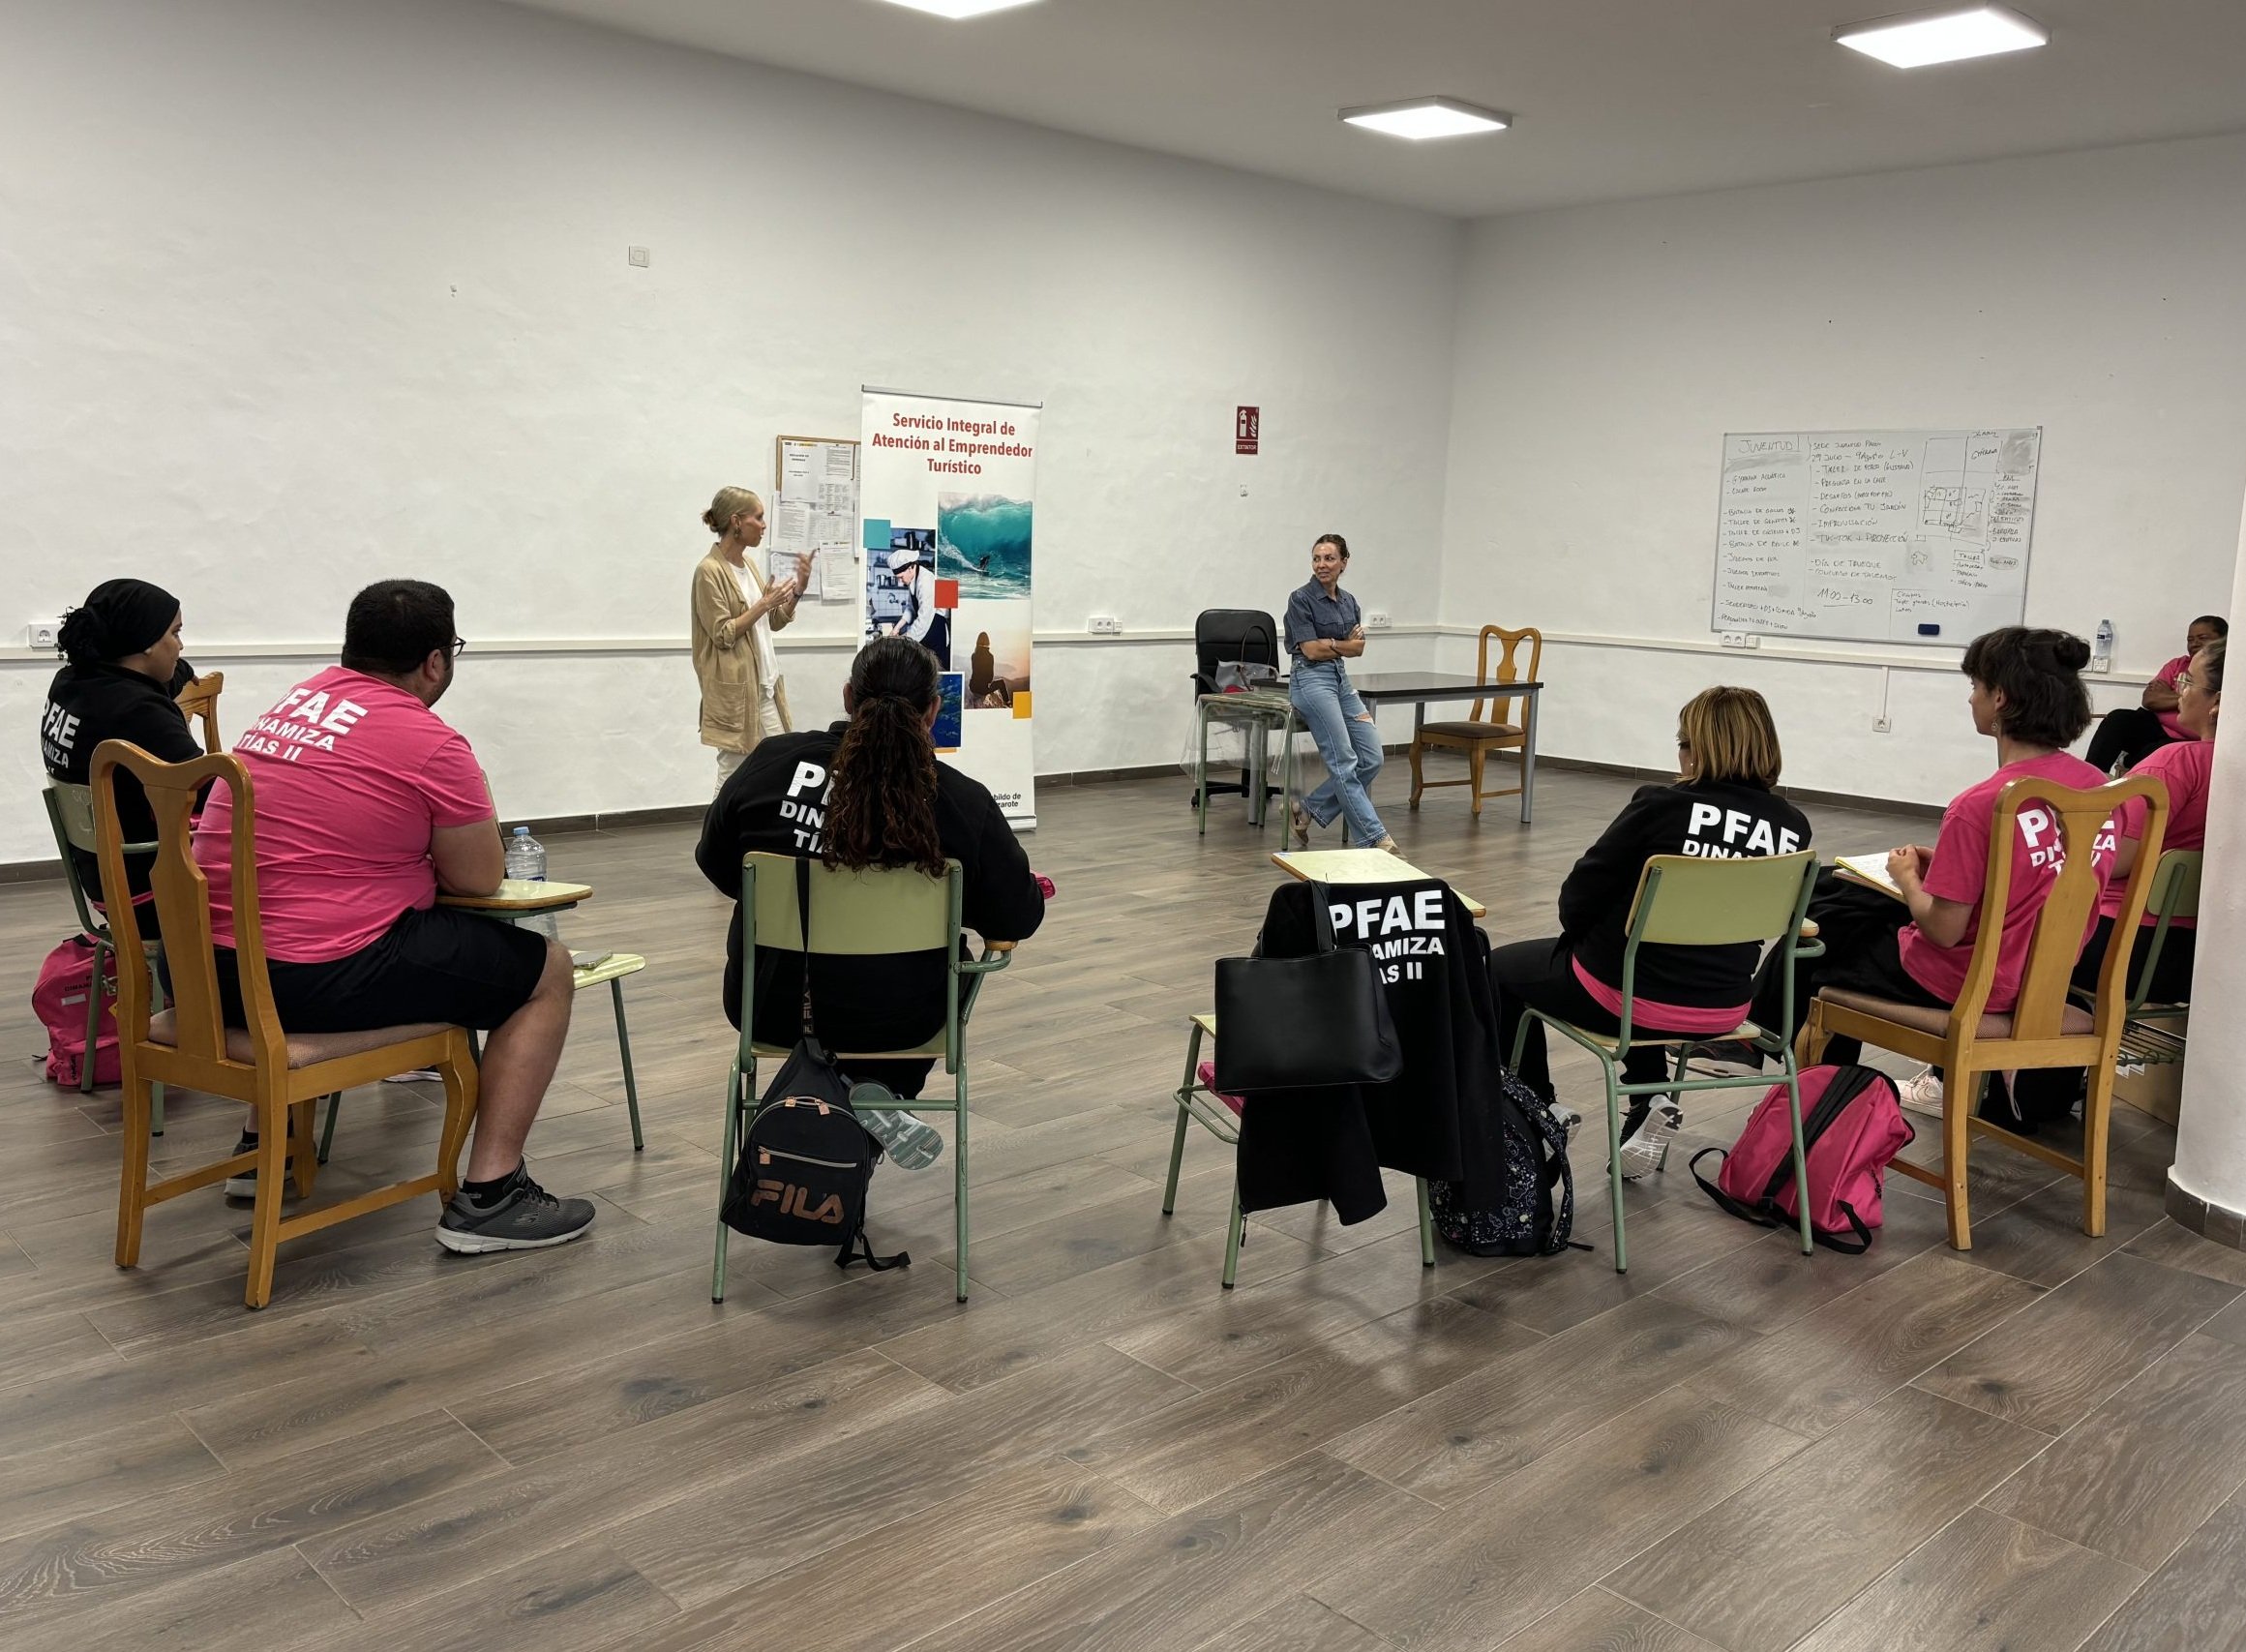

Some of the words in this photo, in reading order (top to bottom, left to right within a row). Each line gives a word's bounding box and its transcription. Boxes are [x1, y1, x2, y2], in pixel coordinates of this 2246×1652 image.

[892, 412, 943, 431] Servicio
[946, 417, 997, 436] Integral
[1000, 422, 1016, 436] de
[872, 433, 930, 450] Atención
[933, 437, 945, 452] al
[948, 439, 1033, 458] Emprendedor
[927, 458, 982, 475] Turístico
[272, 687, 369, 736] FAE
[1329, 889, 1446, 940] PFAE
[1406, 961, 1422, 980] II
[750, 1179, 846, 1225] FILA
